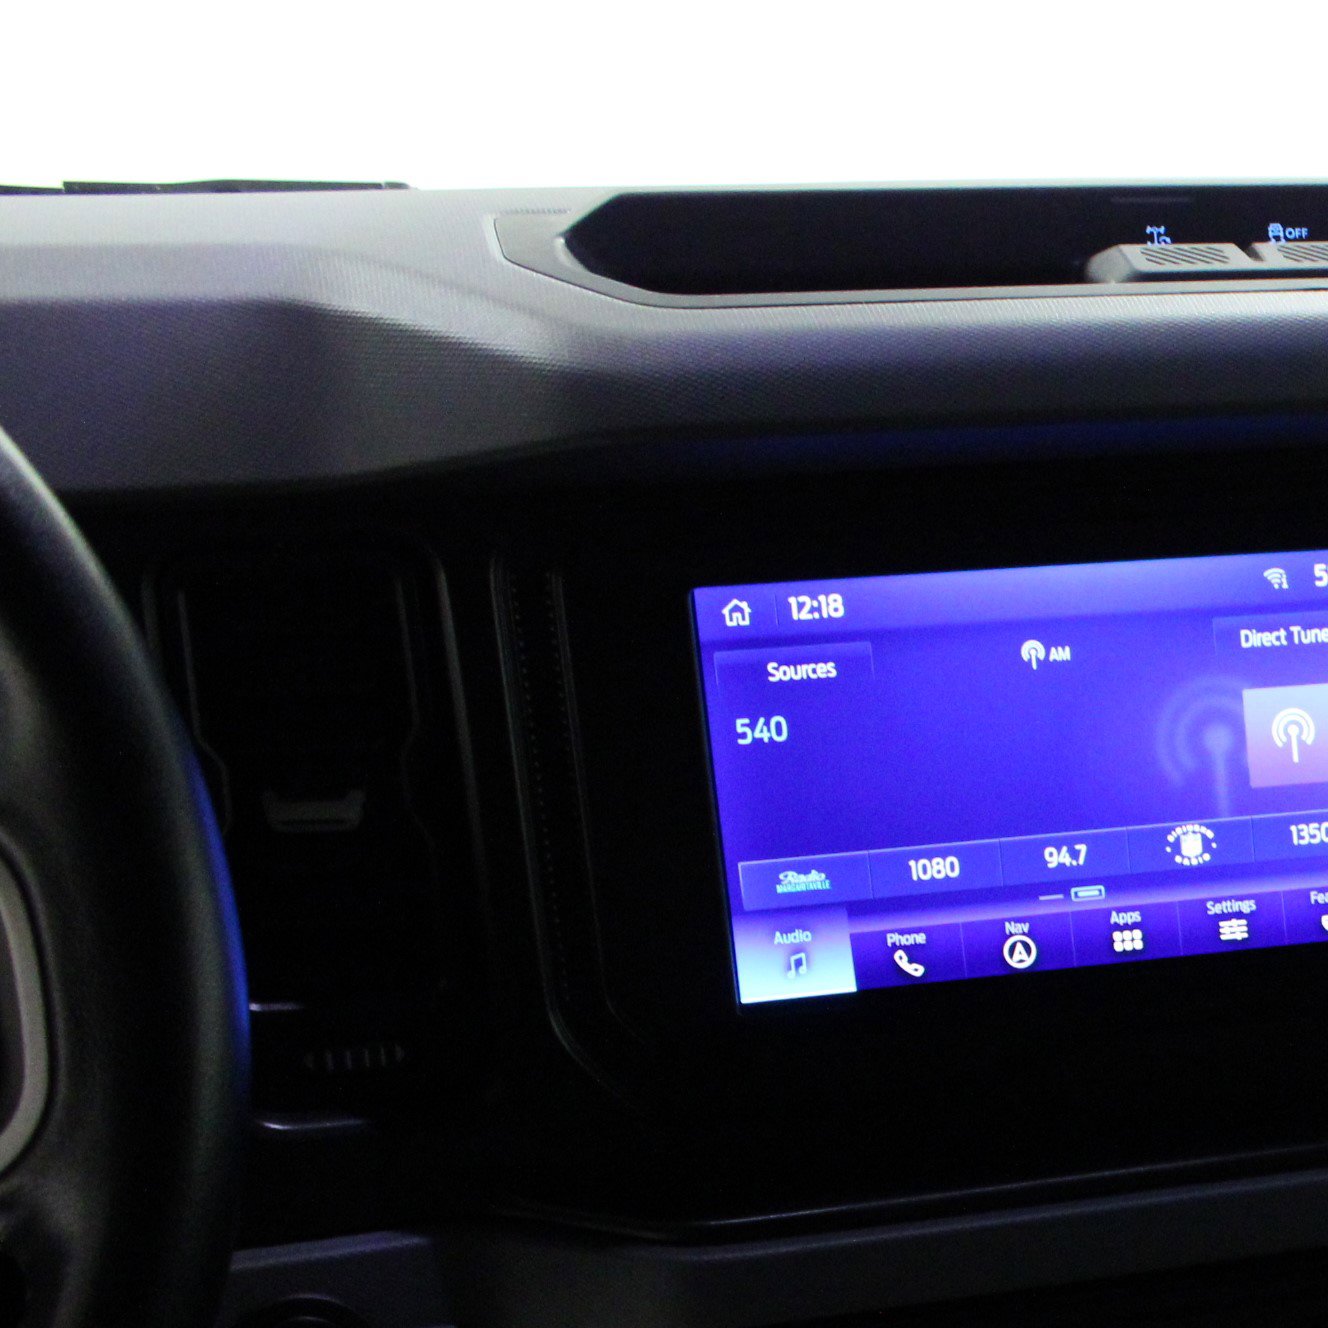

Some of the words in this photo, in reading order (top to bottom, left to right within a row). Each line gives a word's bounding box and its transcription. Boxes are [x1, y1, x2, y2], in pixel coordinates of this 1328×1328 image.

[1285, 227, 1309, 240] OFF
[787, 592, 845, 621] 12:18
[1239, 627, 1288, 649] Direct
[1048, 645, 1072, 662] AM
[766, 661, 838, 683] Sources
[735, 715, 789, 745] 540
[1043, 843, 1088, 869] 94.7
[908, 855, 961, 881] 1080
[1206, 898, 1257, 915] Settings
[1110, 910, 1142, 926] Apps
[1004, 921, 1030, 936] Nav
[773, 929, 813, 946] Audio
[886, 930, 927, 947] Phone
